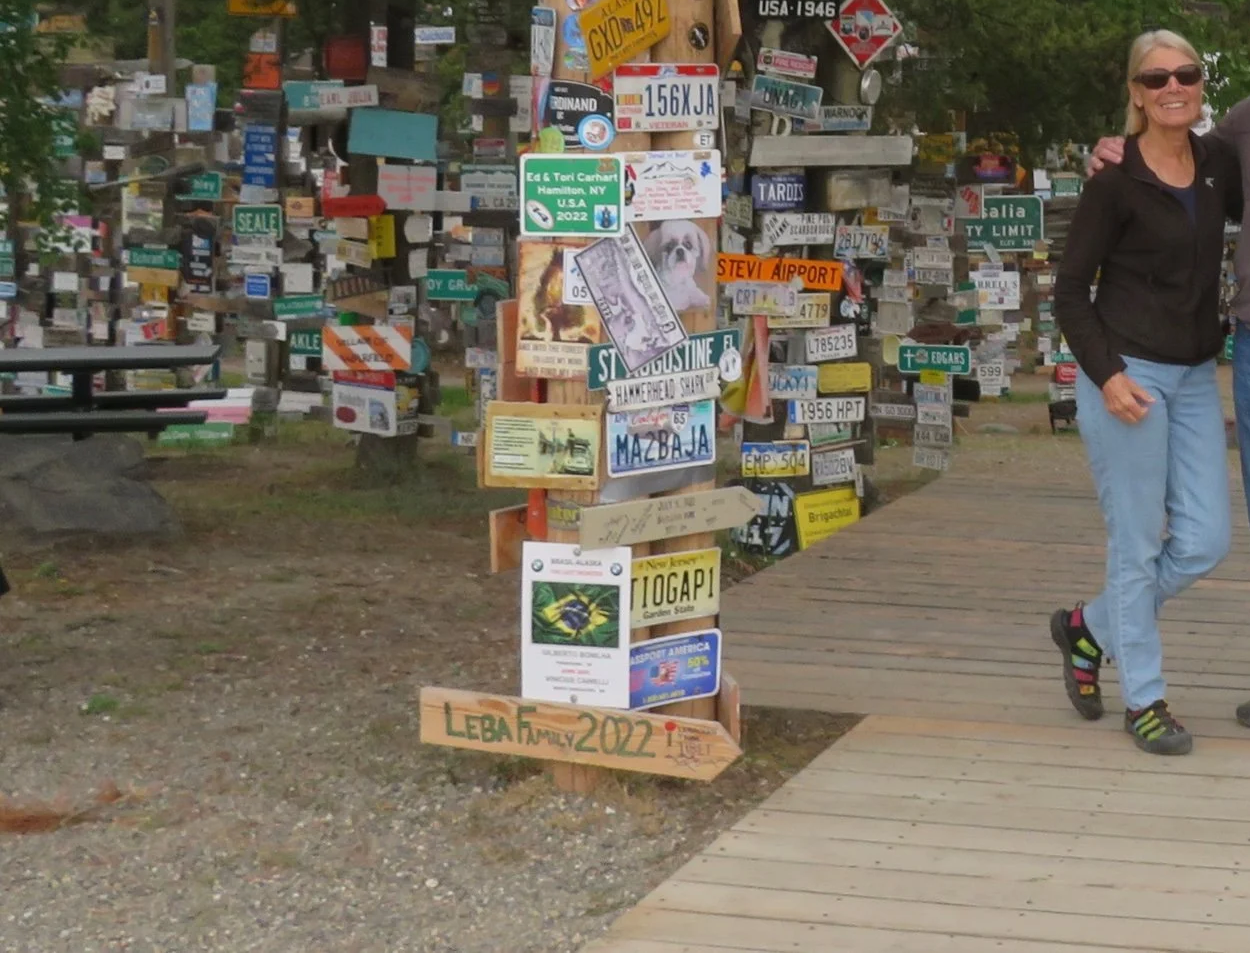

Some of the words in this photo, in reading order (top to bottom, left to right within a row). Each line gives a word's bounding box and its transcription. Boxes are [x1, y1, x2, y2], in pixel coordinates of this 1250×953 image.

[759, 0, 790, 17] USA
[796, 0, 836, 18] 1946
[588, 15, 623, 61] GXD
[645, 84, 715, 117] 156XJA
[771, 112, 792, 136] D
[526, 172, 541, 182] Ed
[543, 172, 551, 182] &
[553, 171, 572, 182] Tori
[574, 171, 618, 183] Carhart
[589, 185, 607, 196] NY
[758, 183, 804, 201] TARDIS
[556, 211, 589, 222] 2022
[981, 204, 1027, 218] salia
[237, 212, 278, 232] SEALE
[992, 224, 1035, 236] LIMIT
[717, 256, 763, 280] STEVI
[771, 259, 840, 285] AIRPORT
[597, 348, 617, 381] ST
[930, 351, 965, 365] EDGARS
[979, 365, 1002, 377] 599
[614, 378, 675, 407] HAMMERHEAD
[680, 375, 705, 398] SHARK
[837, 399, 862, 418] HPT
[673, 412, 686, 425] 65
[615, 423, 710, 467] MA2BAJA
[644, 558, 667, 571] New
[668, 555, 698, 568] Jersey
[642, 606, 672, 621] Garden
[673, 603, 695, 615] State
[630, 648, 667, 666] ASSPORT
[667, 641, 711, 658] AMERICA
[443, 700, 510, 744] LEBA
[576, 711, 656, 758] 2022
